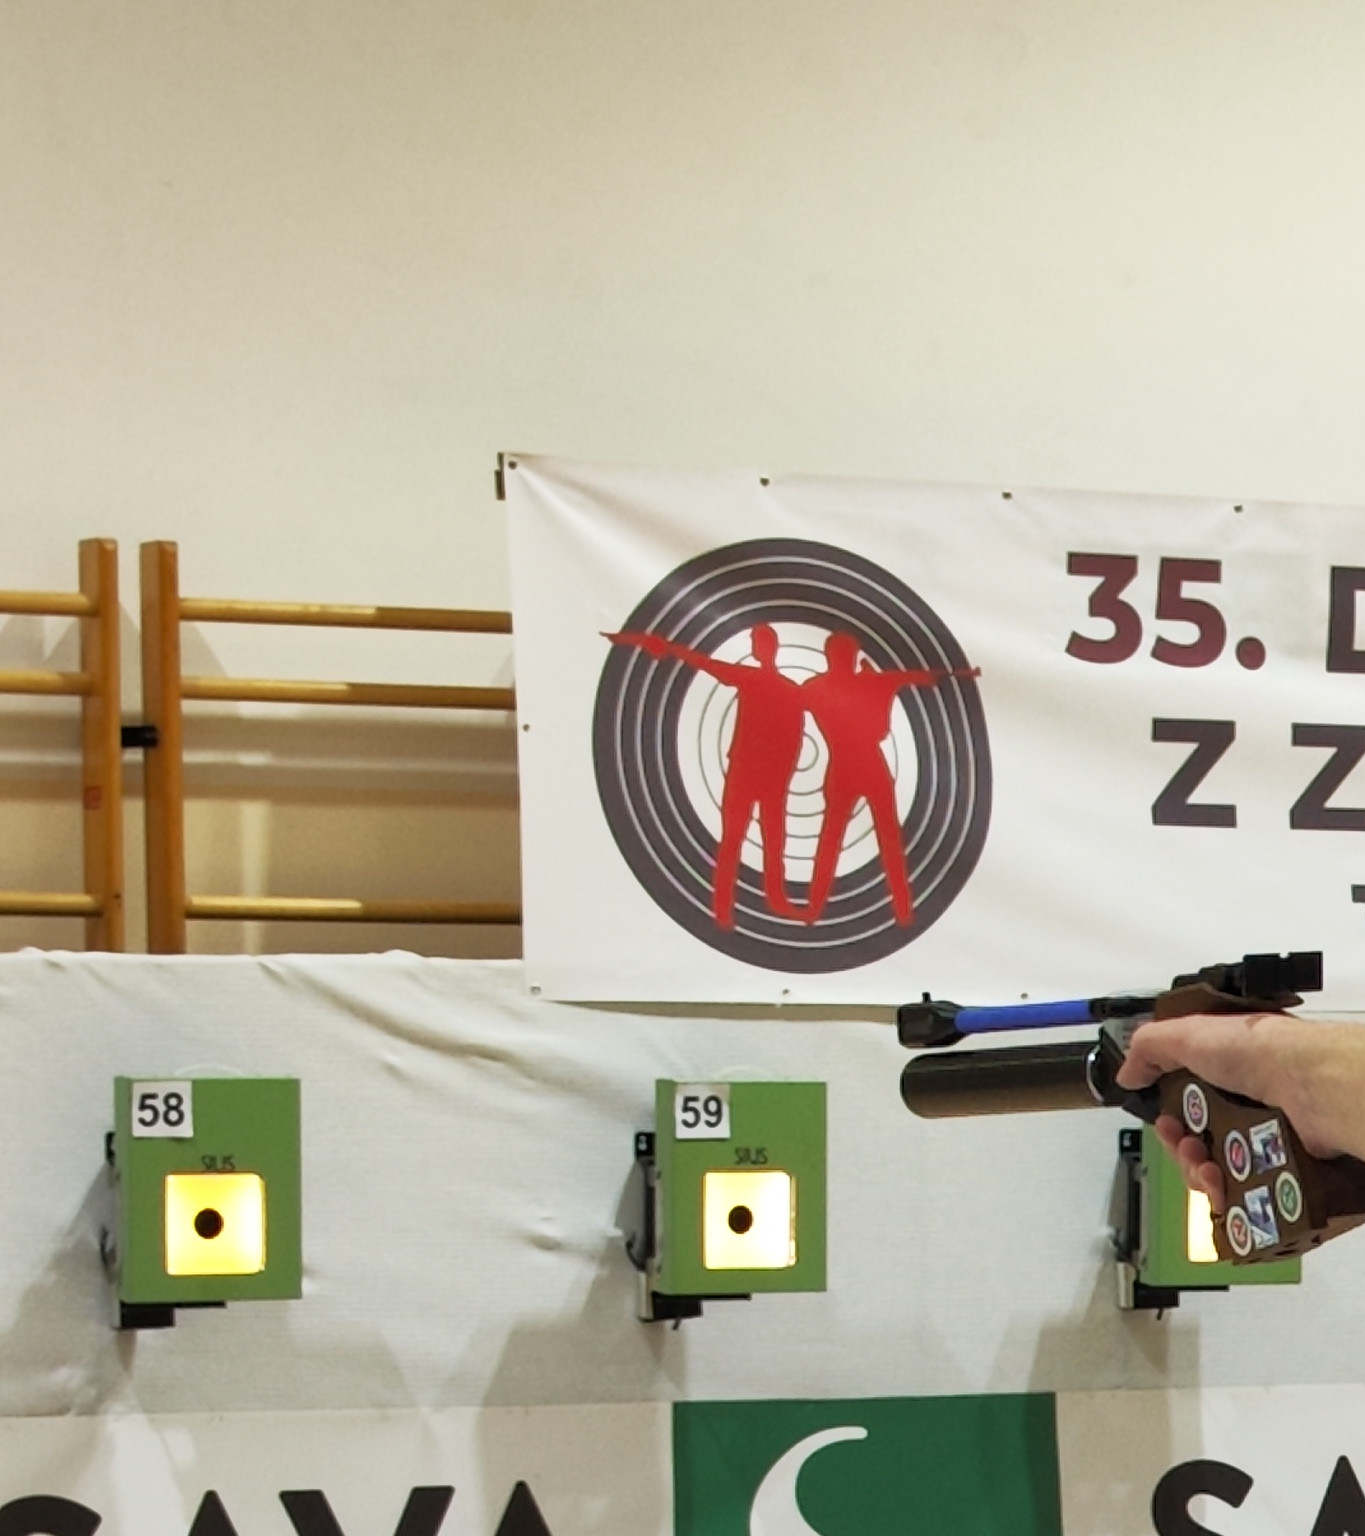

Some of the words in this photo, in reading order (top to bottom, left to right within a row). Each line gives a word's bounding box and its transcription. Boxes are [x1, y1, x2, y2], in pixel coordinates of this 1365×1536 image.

[1065, 552, 1266, 670] 35.
[1151, 718, 1237, 828] Z
[138, 1091, 185, 1128] 58
[681, 1095, 723, 1129] 59
